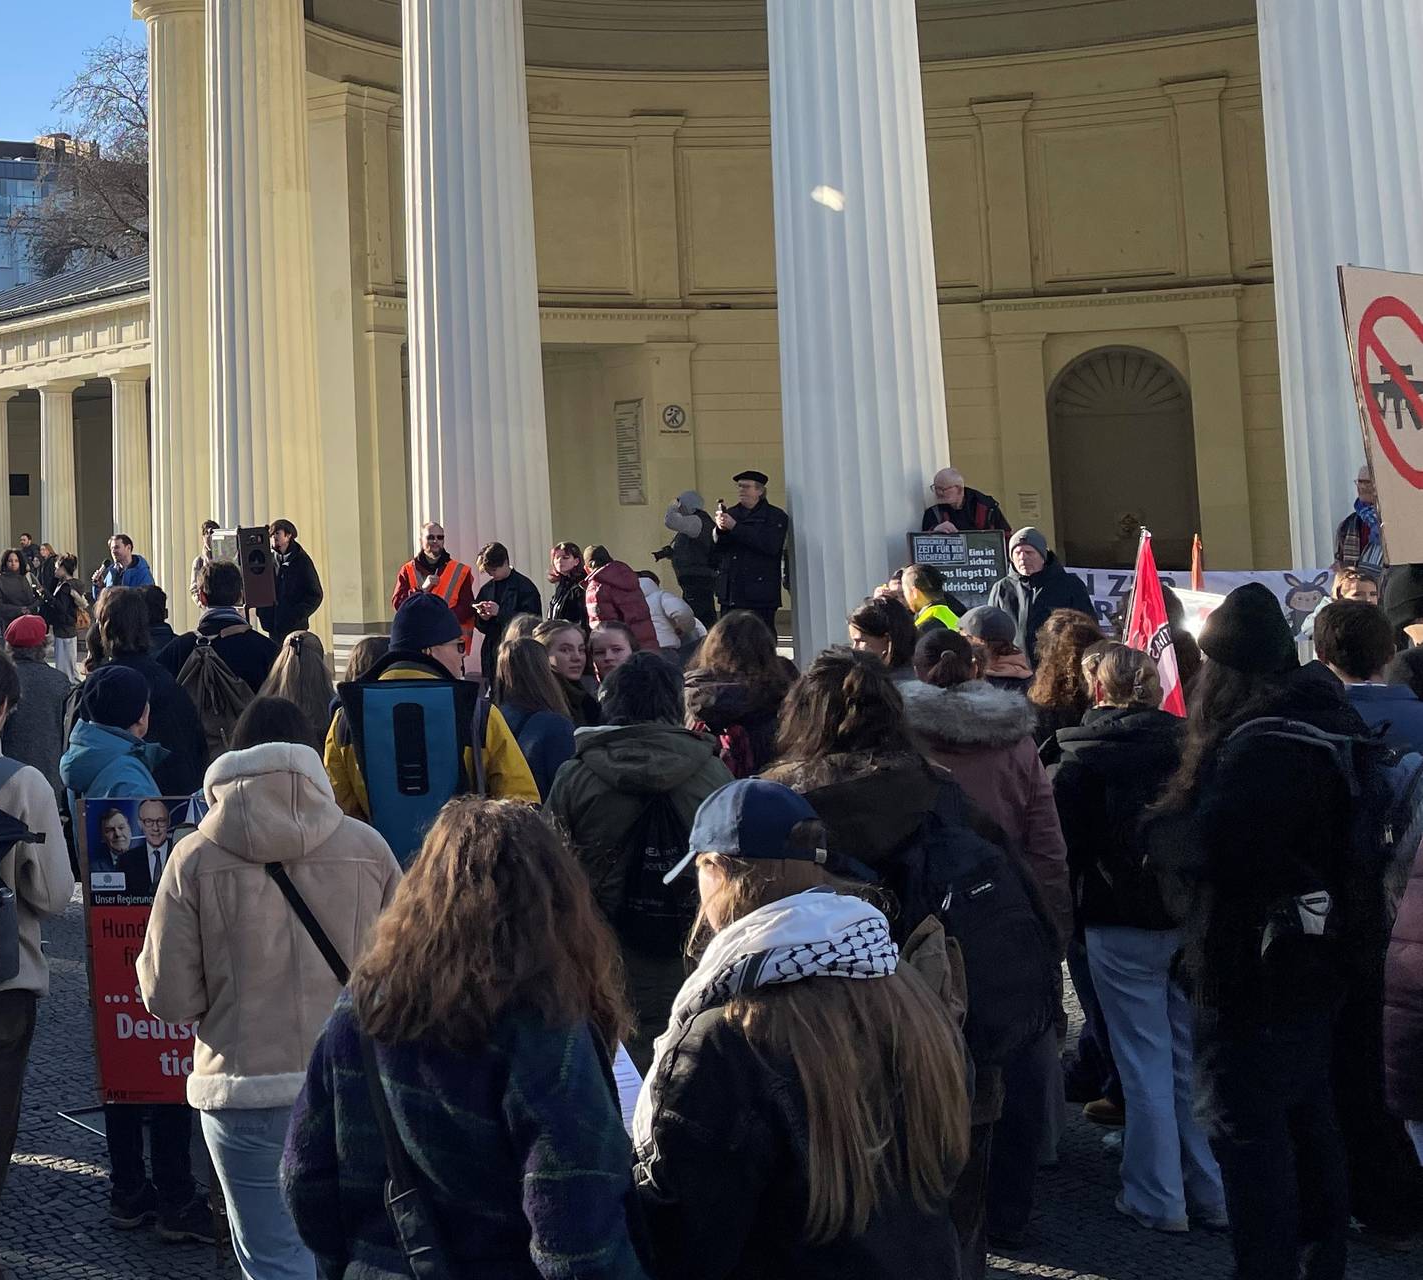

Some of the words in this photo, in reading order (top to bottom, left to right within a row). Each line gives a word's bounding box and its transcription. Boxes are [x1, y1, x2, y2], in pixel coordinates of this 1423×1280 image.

[918, 545, 934, 554] ZEIT
[936, 544, 950, 554] FÜR
[968, 548, 984, 557] Eins
[985, 548, 995, 556] ist
[969, 557, 995, 566] sicher:
[940, 570, 954, 578] ns
[956, 567, 982, 580] liegst
[983, 568, 997, 577] Du
[943, 581, 988, 594] ldrichtig!
[95, 894, 116, 904] Unser
[117, 894, 154, 906] Regierung
[102, 918, 147, 938] Hund
[116, 1013, 200, 1039] Deutsc
[159, 1049, 194, 1076] tic
